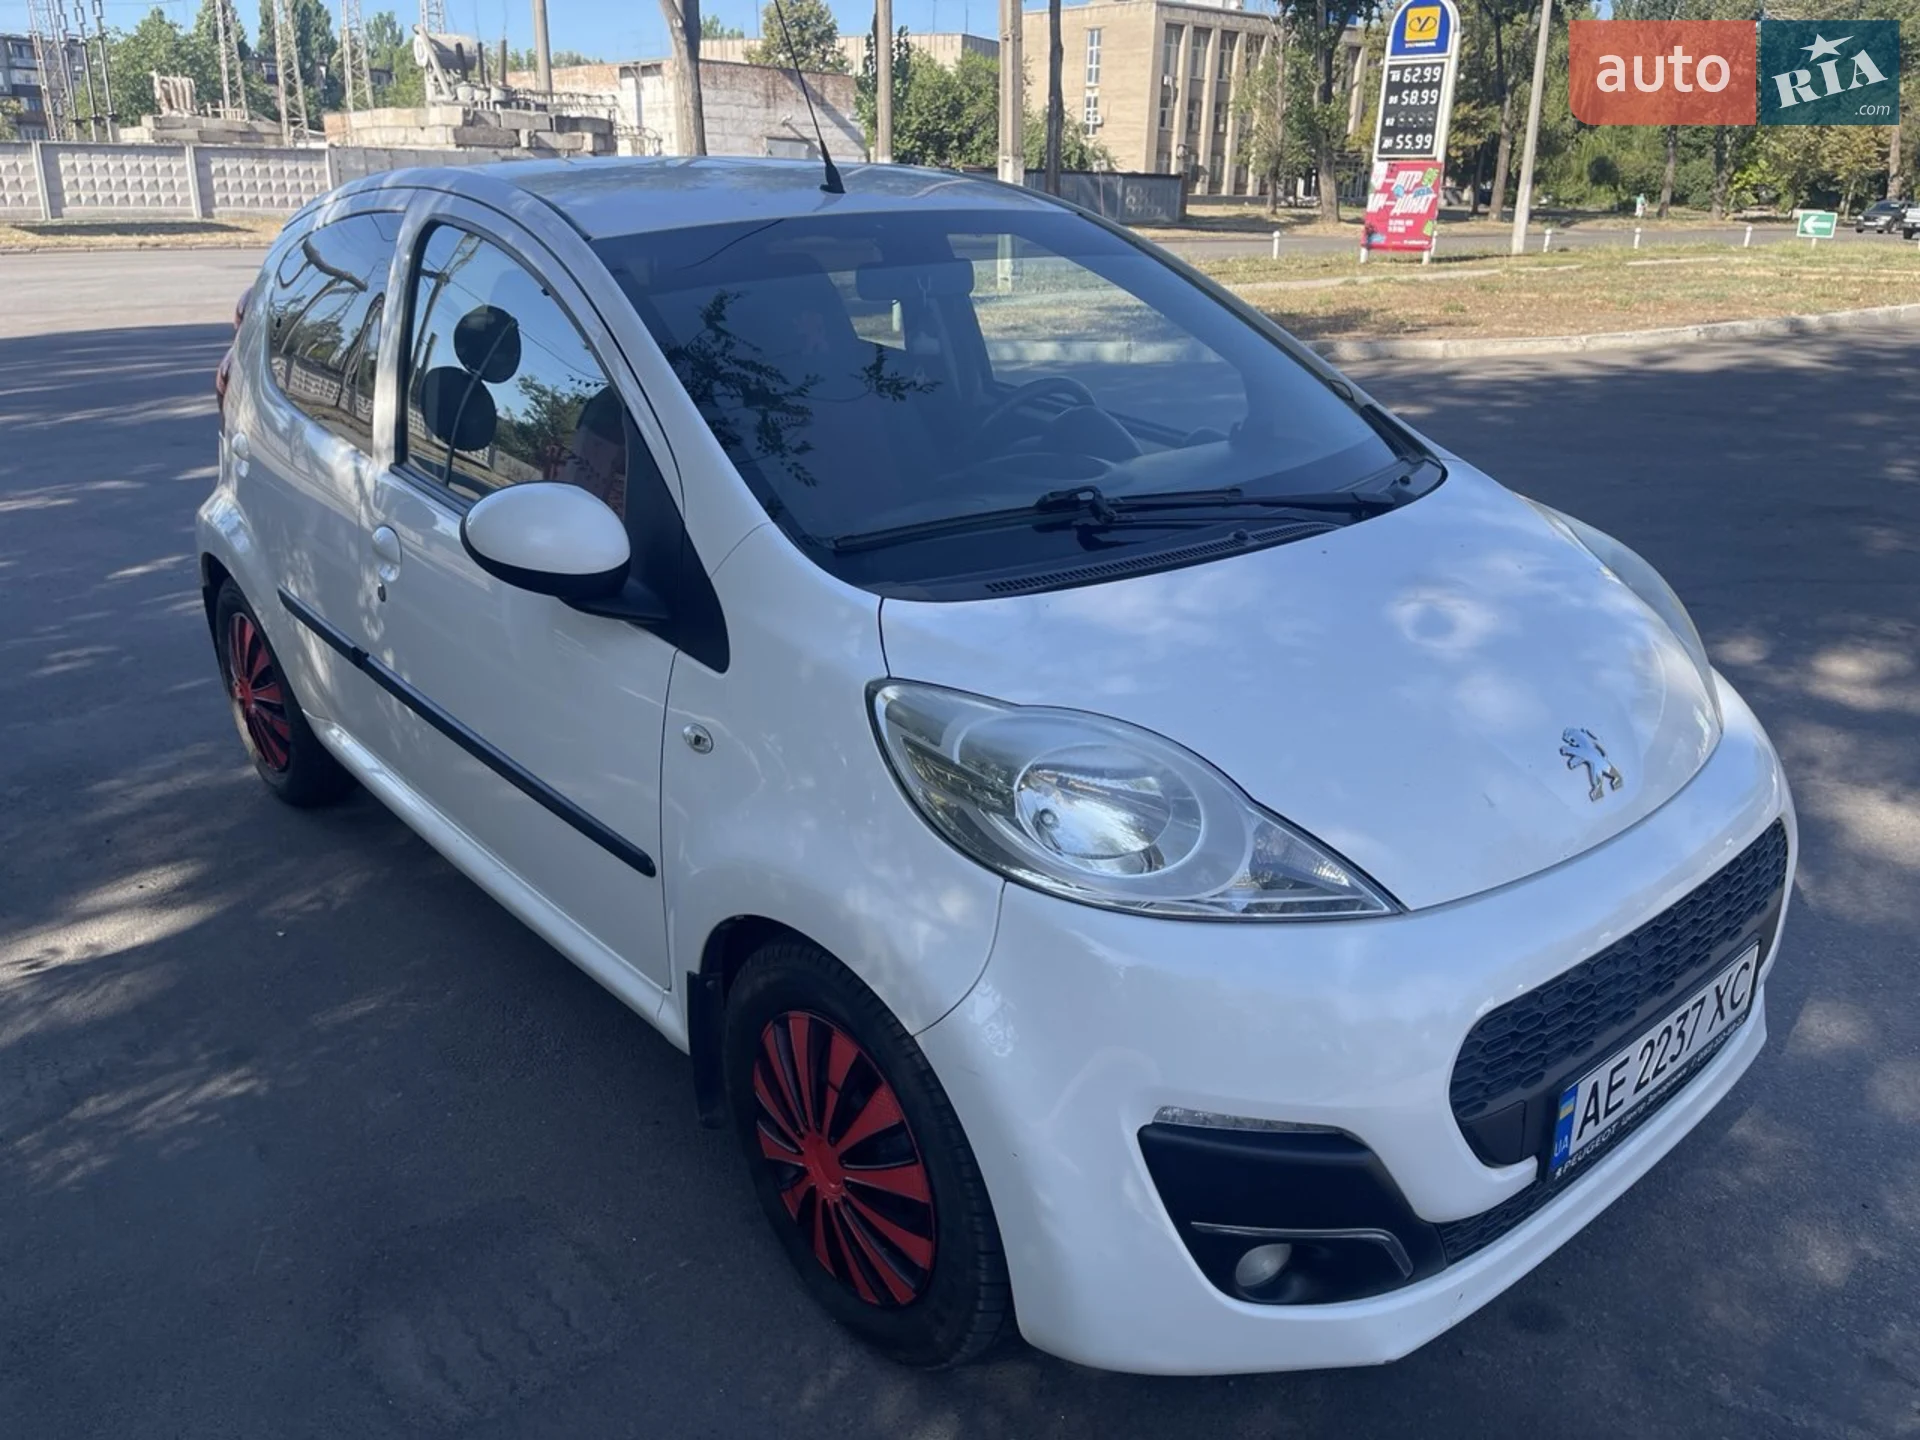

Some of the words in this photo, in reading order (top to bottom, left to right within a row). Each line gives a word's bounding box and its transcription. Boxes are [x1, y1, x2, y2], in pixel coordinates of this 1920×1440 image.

[1403, 66, 1442, 83] 62.99
[1400, 89, 1438, 106] 58.99
[1395, 133, 1433, 150] 55.99
[1576, 1056, 1630, 1141] AE
[1633, 995, 1707, 1095] 2237
[1707, 961, 1750, 1034] XC
[1554, 1135, 1569, 1157] UA
[1563, 1121, 1618, 1174] PEUGEOT
